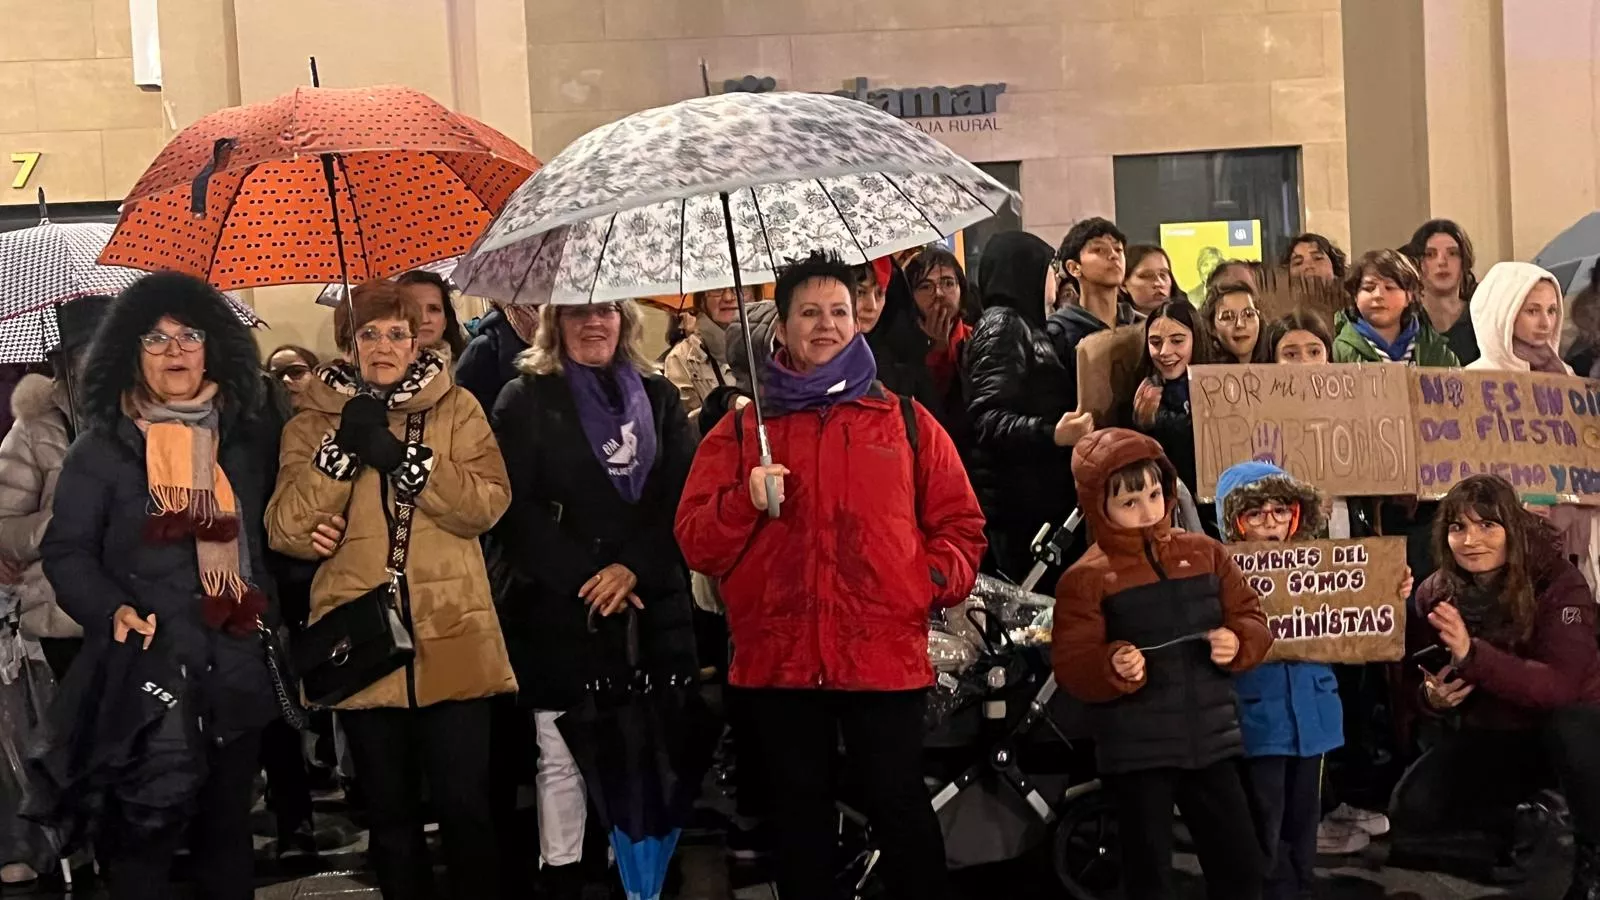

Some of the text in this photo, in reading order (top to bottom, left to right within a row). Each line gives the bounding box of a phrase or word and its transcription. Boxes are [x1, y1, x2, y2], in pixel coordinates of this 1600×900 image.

[949, 118, 1002, 132] RURAL
[11, 152, 42, 189] 7
[1200, 371, 1262, 407] POR
[1310, 371, 1355, 399] POR
[1481, 380, 1521, 413] ES
[1548, 463, 1567, 492] Y
[1332, 544, 1368, 565] DEL
[1287, 568, 1365, 596] SOMOS
